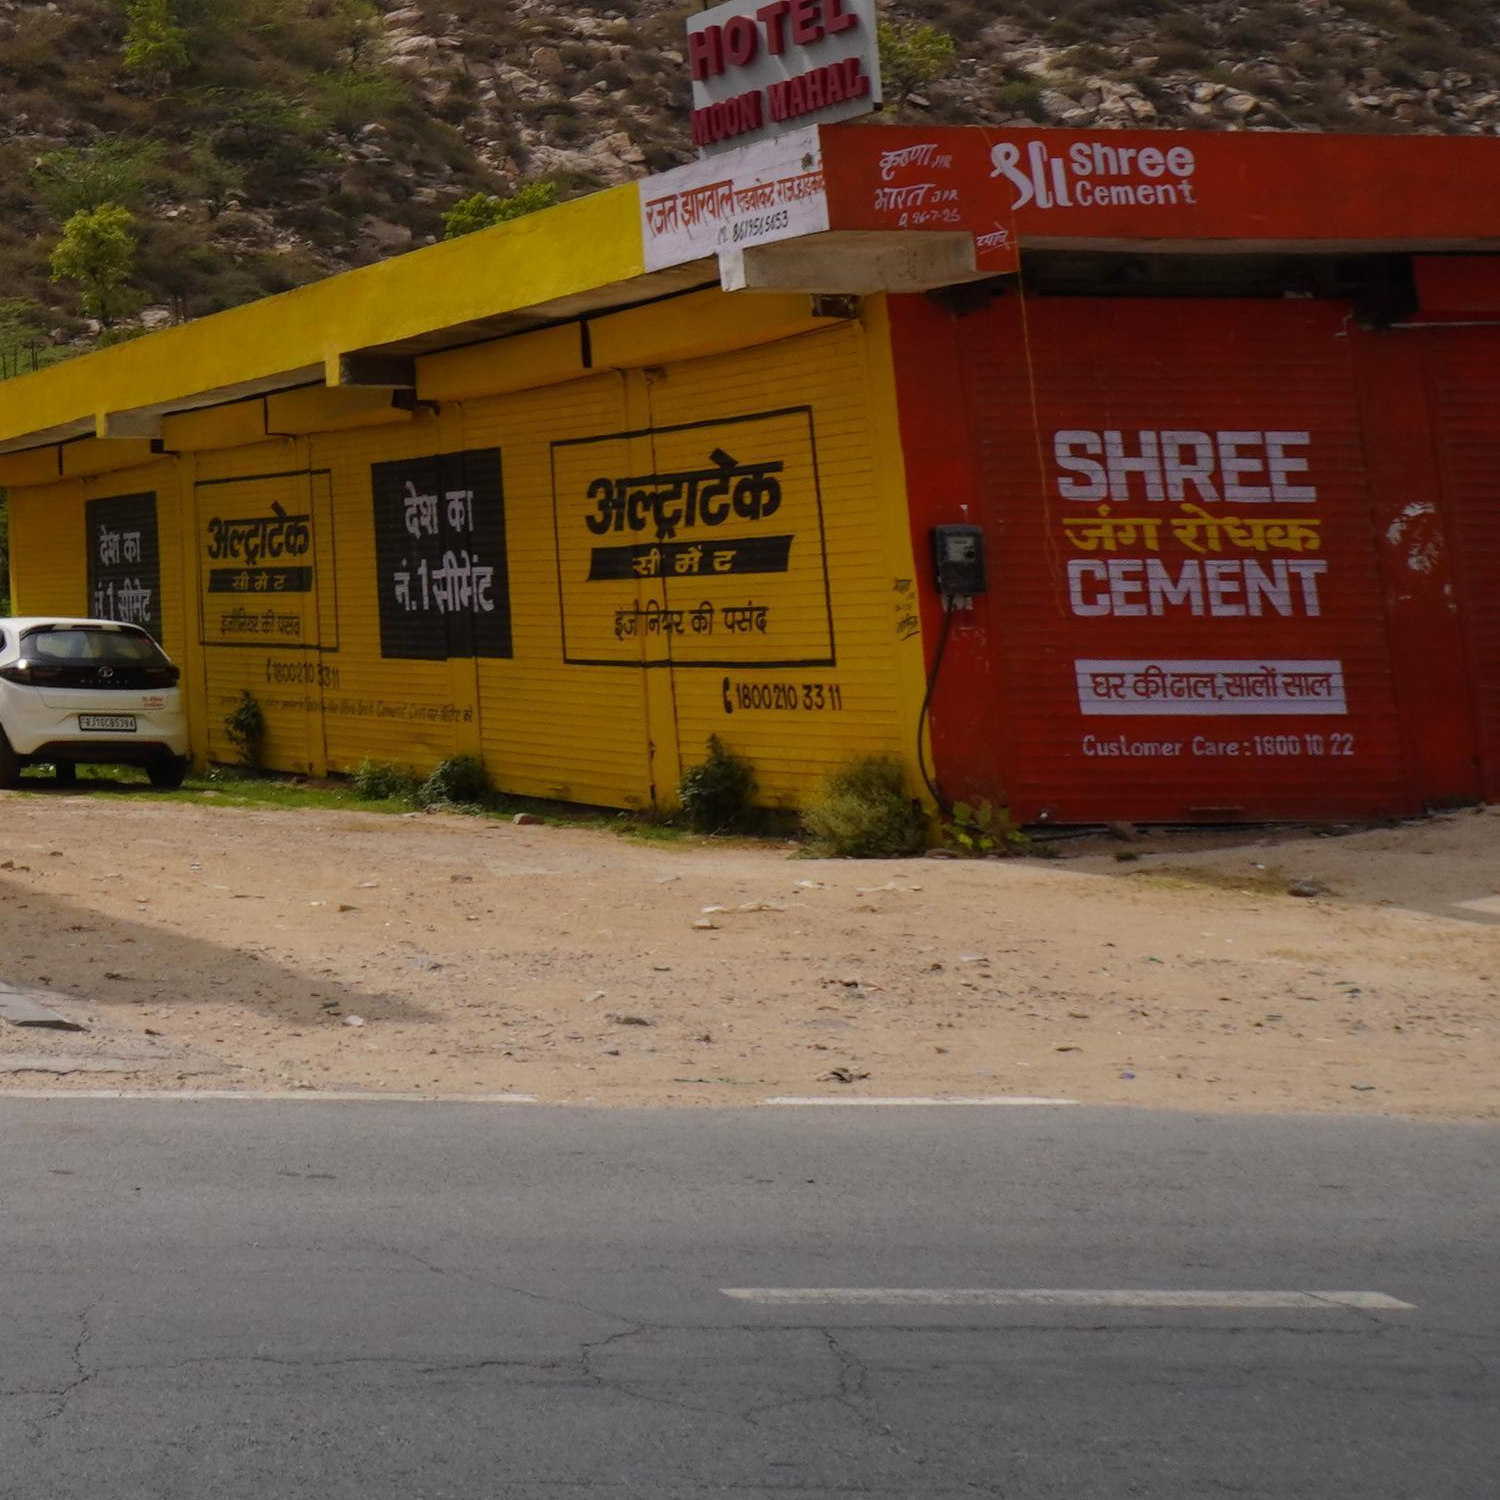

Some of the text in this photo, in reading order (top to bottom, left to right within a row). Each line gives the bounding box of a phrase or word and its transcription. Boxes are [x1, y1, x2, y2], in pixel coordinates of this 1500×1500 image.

[689, 57, 870, 147] MOON MAHAL
[1075, 179, 1197, 206] Cement
[585, 448, 784, 539] अल्ट्राटेक
[1053, 429, 1318, 503] SHREE
[207, 500, 310, 565] अल्ट्राटेक
[404, 481, 474, 540] देश का
[1062, 503, 1321, 553] जंग रोधक
[100, 524, 141, 566] देश का
[417, 558, 430, 611] 1
[431, 550, 495, 615] सीमेंट
[1067, 559, 1328, 617] CEMENT
[689, 600, 713, 635] की
[722, 601, 769, 634] पसंद
[1090, 673, 1126, 698] घर
[1133, 665, 1168, 699] की
[1223, 666, 1277, 697] सालों
[1281, 673, 1332, 697] साल
[1082, 735, 1182, 756] Customer
